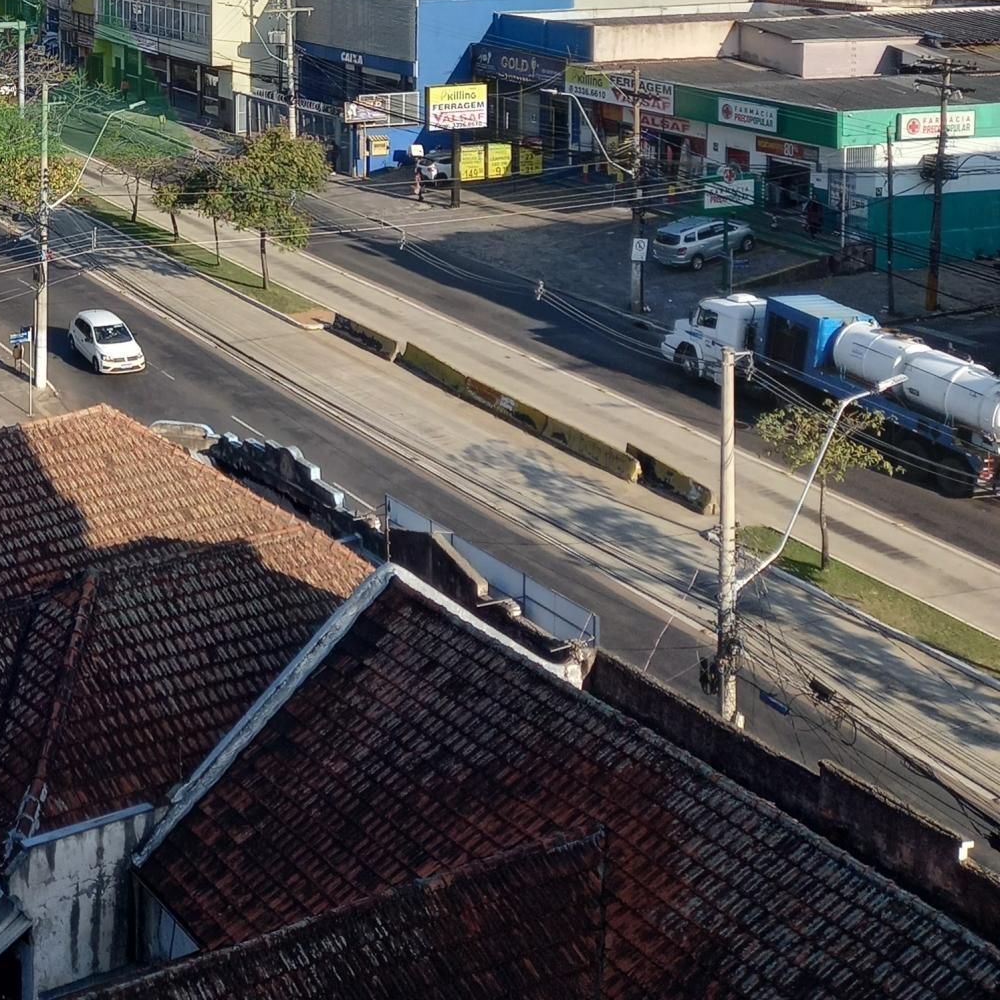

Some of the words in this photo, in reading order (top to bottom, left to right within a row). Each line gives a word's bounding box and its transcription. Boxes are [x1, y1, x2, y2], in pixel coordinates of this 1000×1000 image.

[340, 51, 364, 65] CAIXA
[500, 55, 530, 72] GOLD
[610, 76, 672, 96] FERAGEM
[432, 101, 485, 111] FERRAGEM
[632, 112, 691, 133] ALSAF
